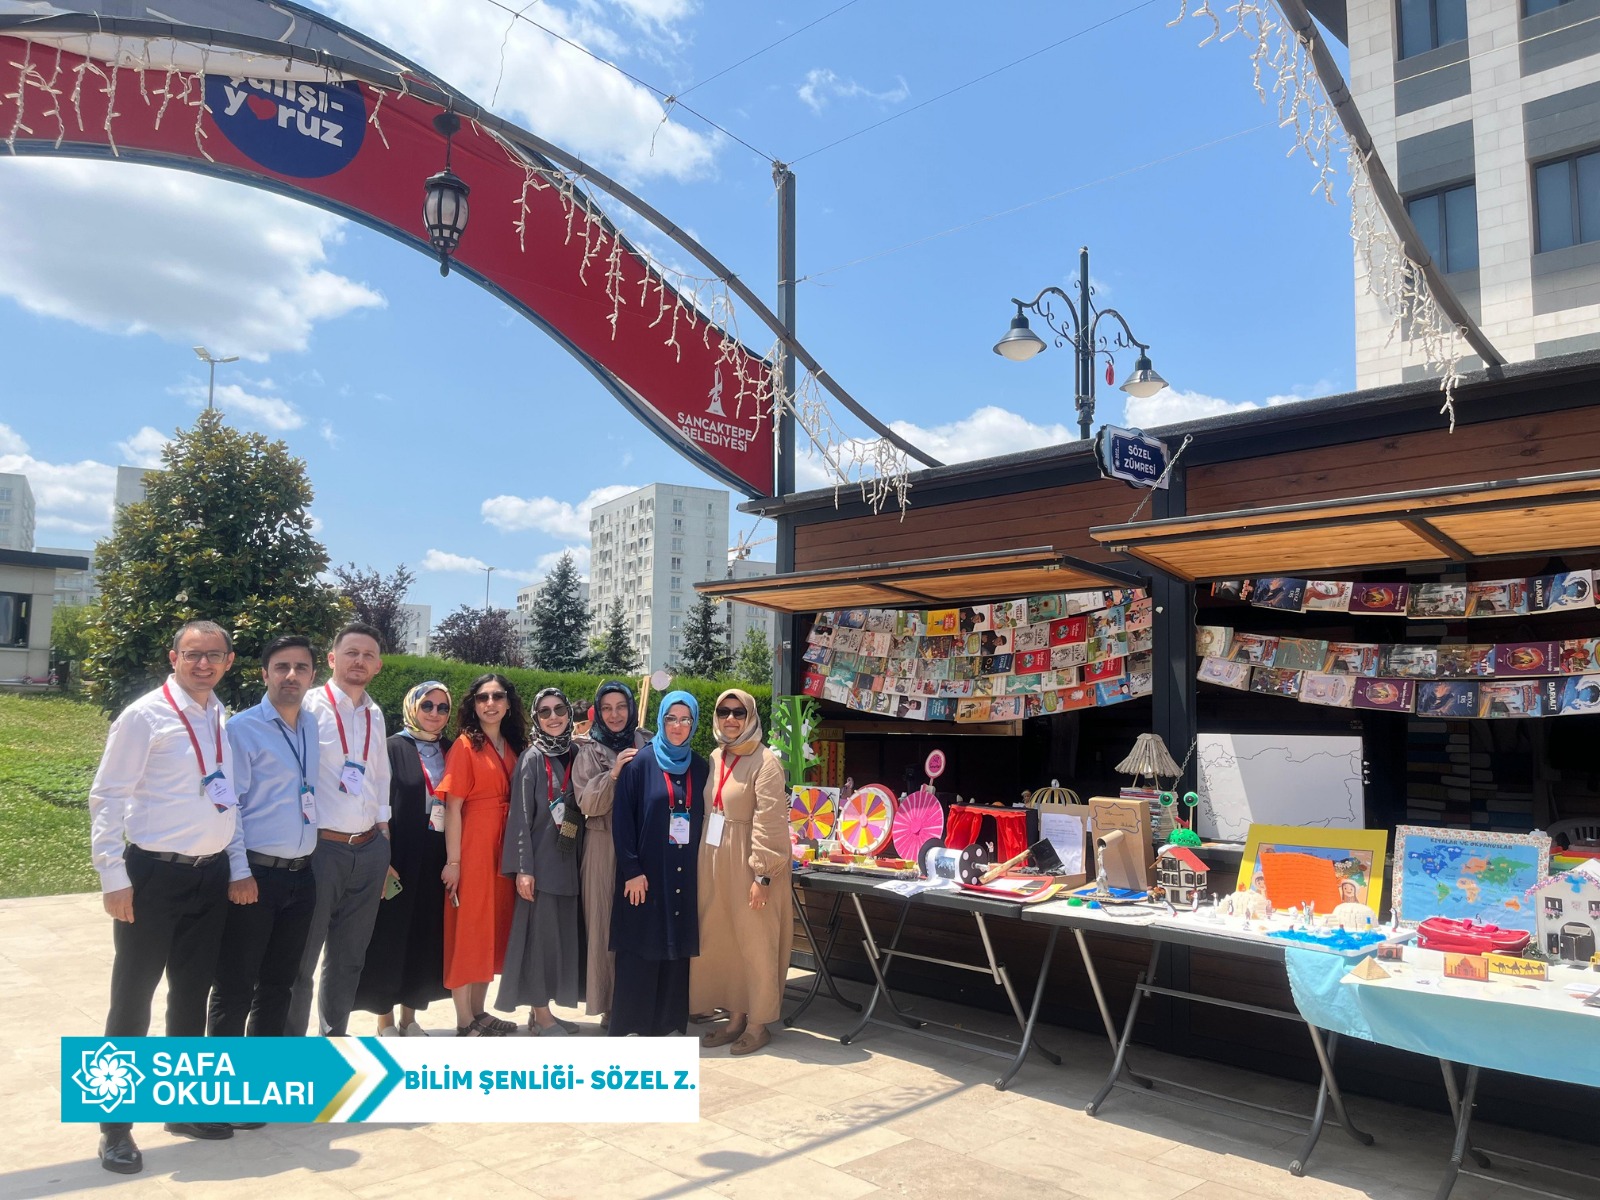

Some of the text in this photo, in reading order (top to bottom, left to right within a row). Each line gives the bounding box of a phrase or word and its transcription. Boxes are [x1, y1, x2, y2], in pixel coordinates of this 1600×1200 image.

[677, 412, 752, 440] SANCAKTEPE
[682, 426, 747, 452] BELEDİYESİ
[1128, 444, 1151, 460] SÖZEL
[1124, 457, 1156, 475] ZÜMRESİ
